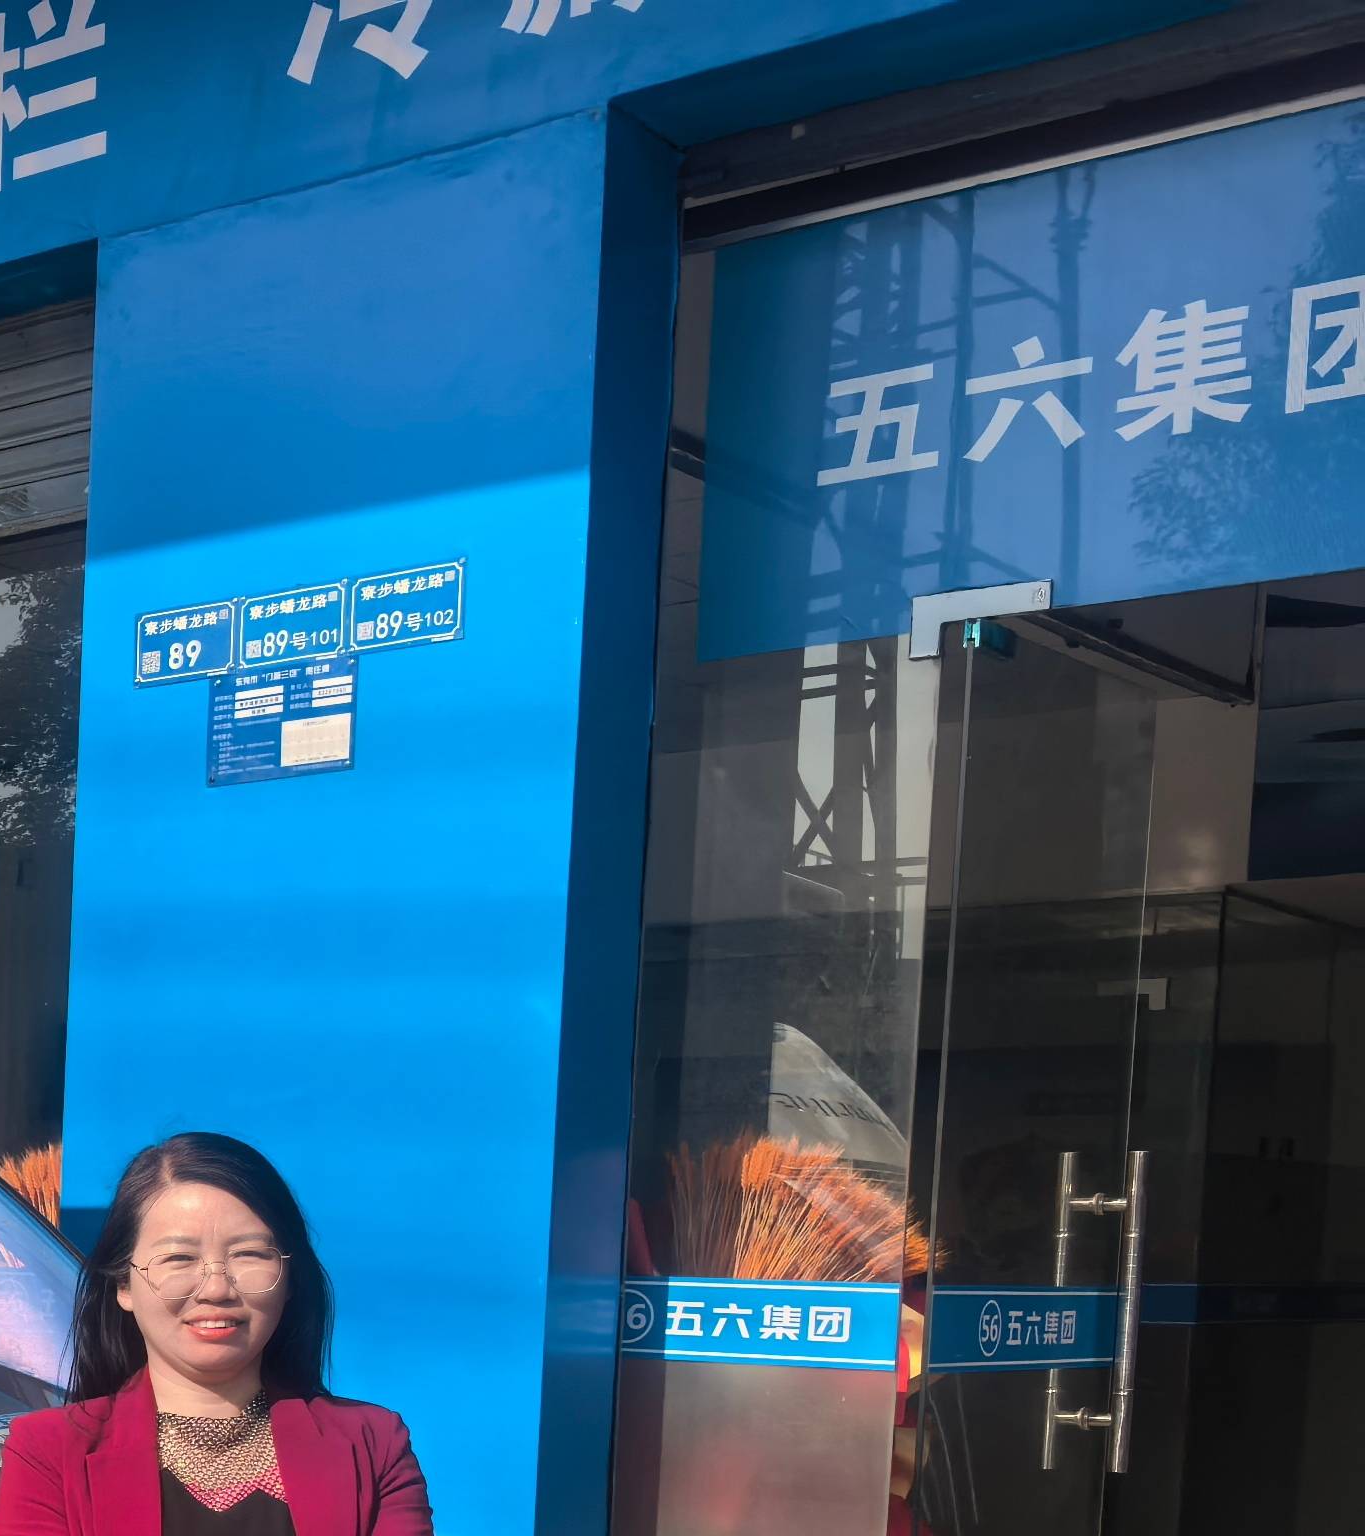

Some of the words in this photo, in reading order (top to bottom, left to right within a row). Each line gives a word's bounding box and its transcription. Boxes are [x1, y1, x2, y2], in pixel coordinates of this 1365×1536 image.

[817, 276, 1365, 487] 五六集团
[360, 572, 445, 601] 寮步蟠龙路
[249, 591, 328, 621] 寮步蟠龙路
[144, 610, 219, 636] 寮步蟠龙路
[375, 609, 455, 639] 89号102
[168, 640, 202, 670] 89
[262, 628, 339, 657] 89号101
[665, 1301, 852, 1343] 五六集团
[981, 1313, 1000, 1344] 56
[1006, 1309, 1076, 1346] 五六集团
